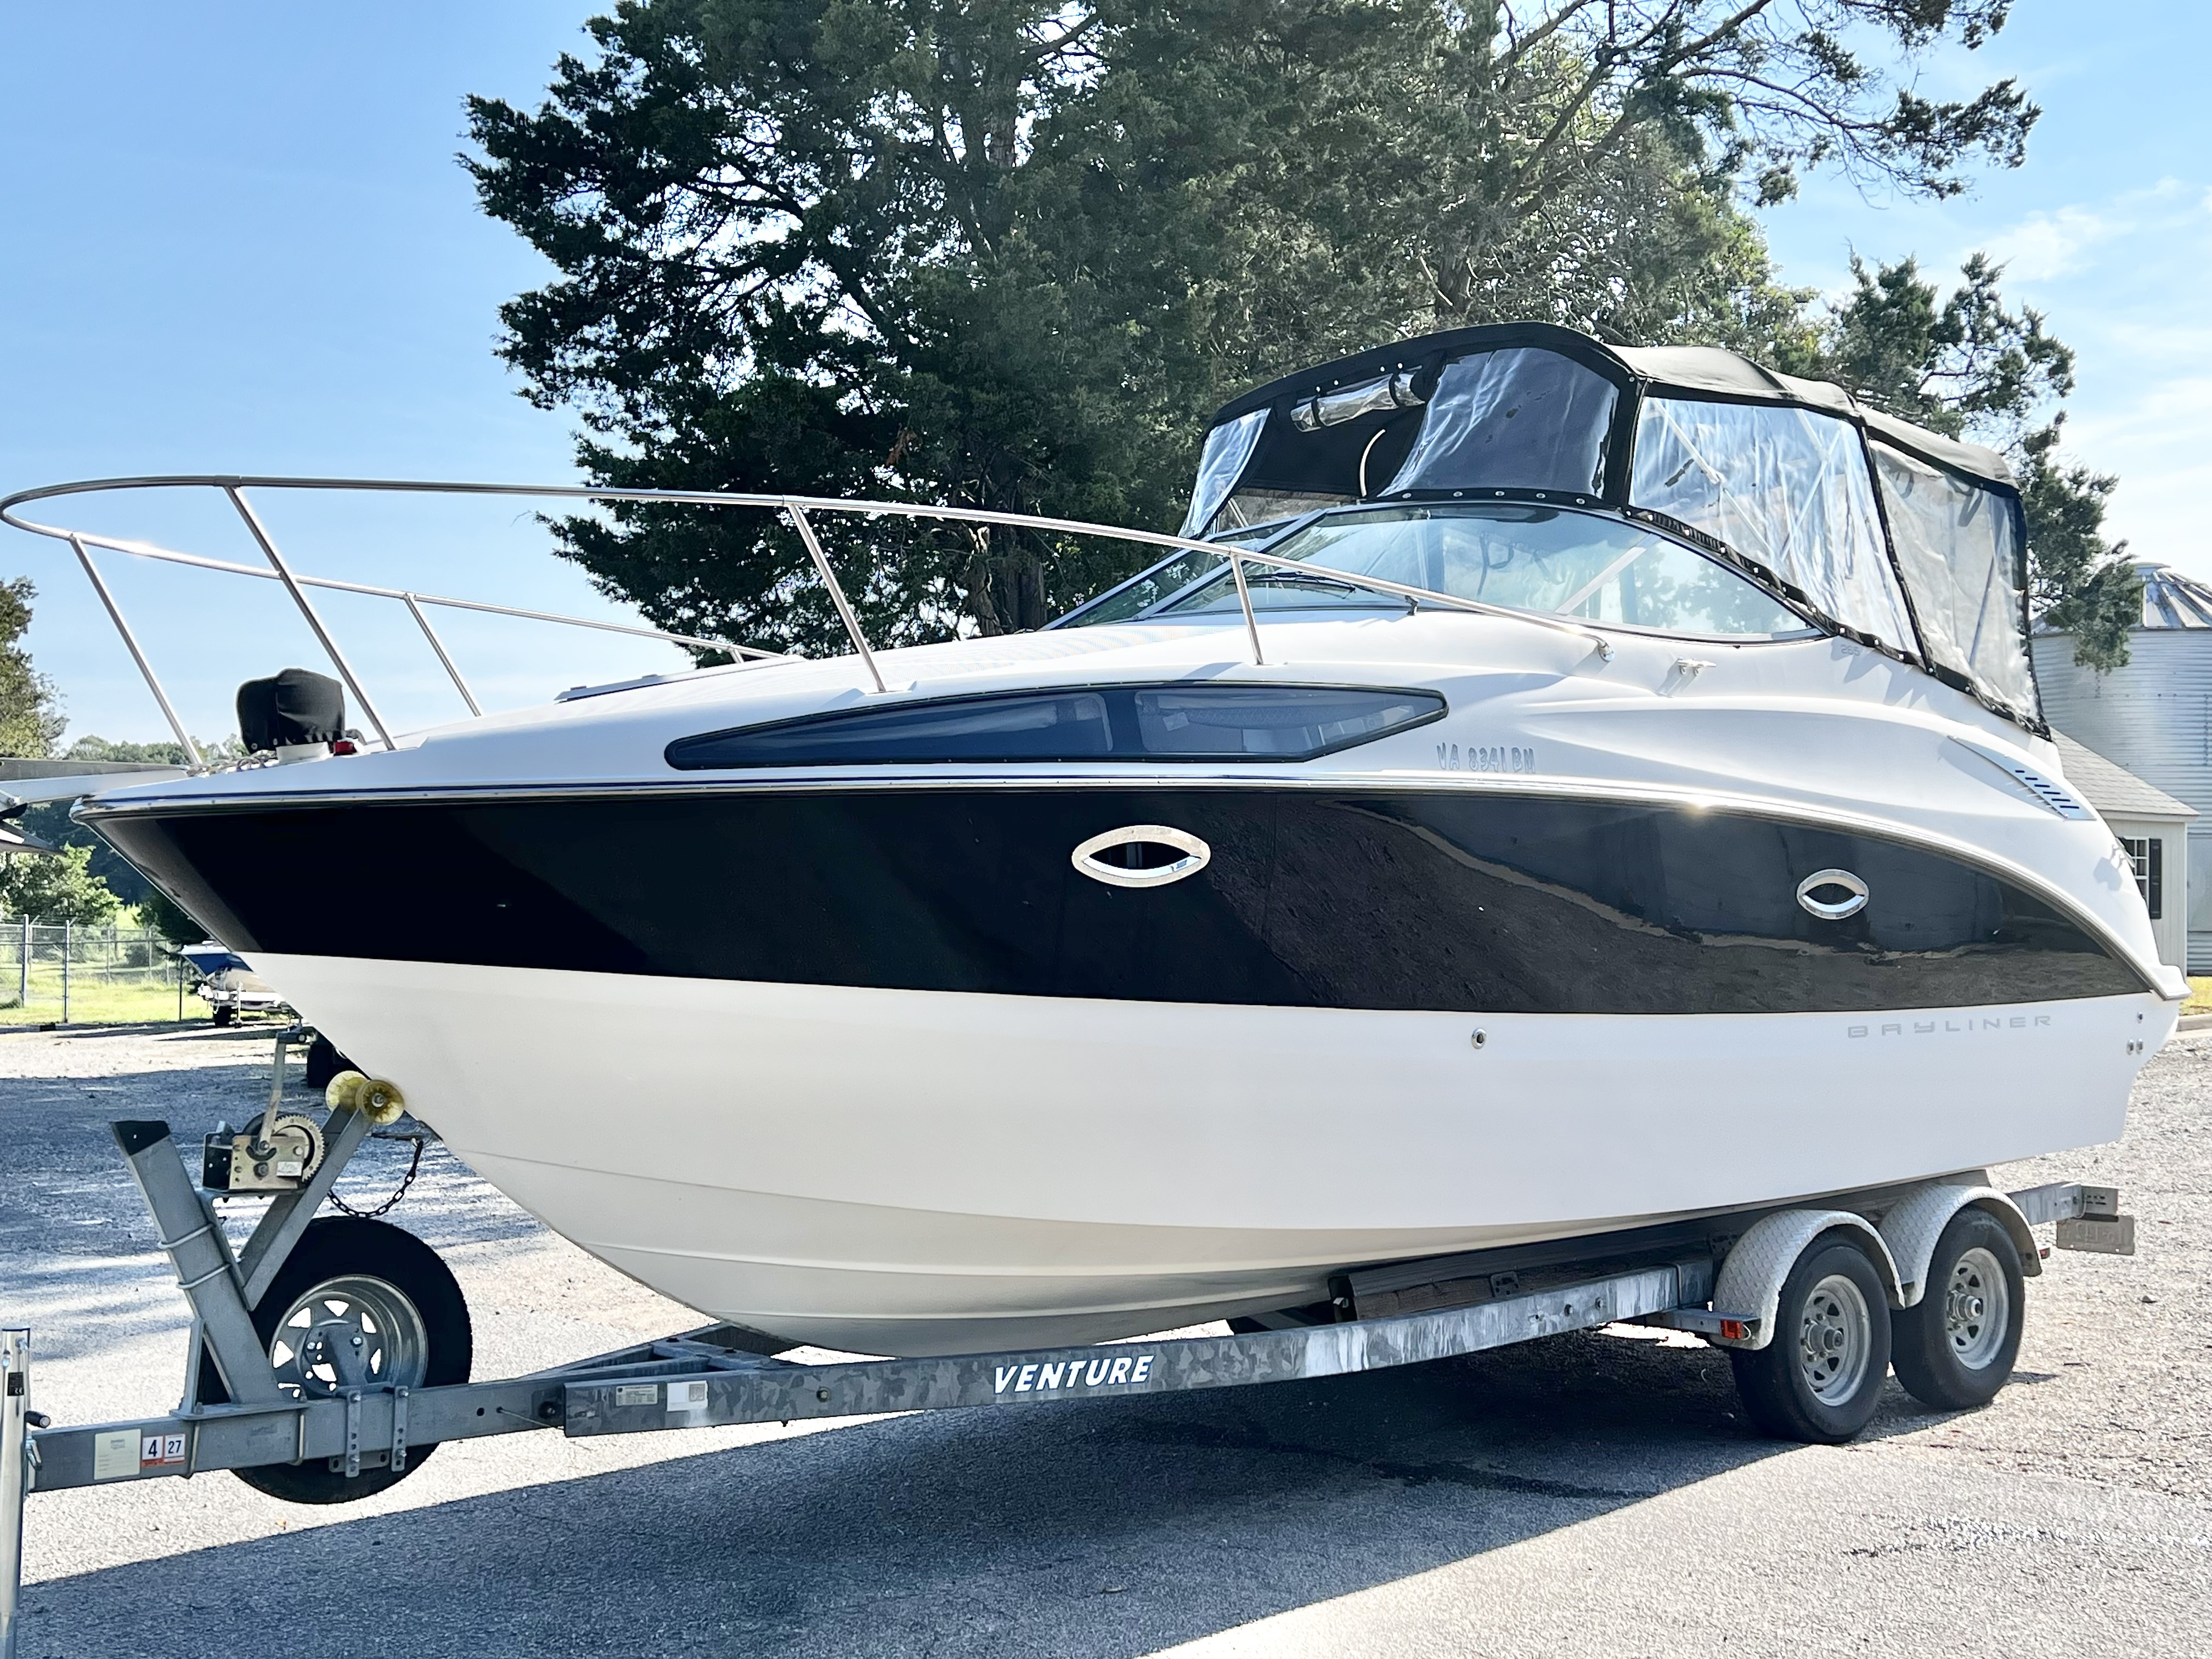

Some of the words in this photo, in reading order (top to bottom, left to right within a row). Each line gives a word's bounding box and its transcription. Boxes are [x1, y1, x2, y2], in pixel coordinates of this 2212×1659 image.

[1841, 644, 1860, 656] 265
[1436, 742, 1460, 770] VA
[1468, 746, 1507, 772] 8341
[1848, 1015, 2051, 1038] BAYLINER
[994, 1355, 1154, 1395] VENTURE
[148, 1440, 157, 1457] 4
[168, 1440, 182, 1454] 27
